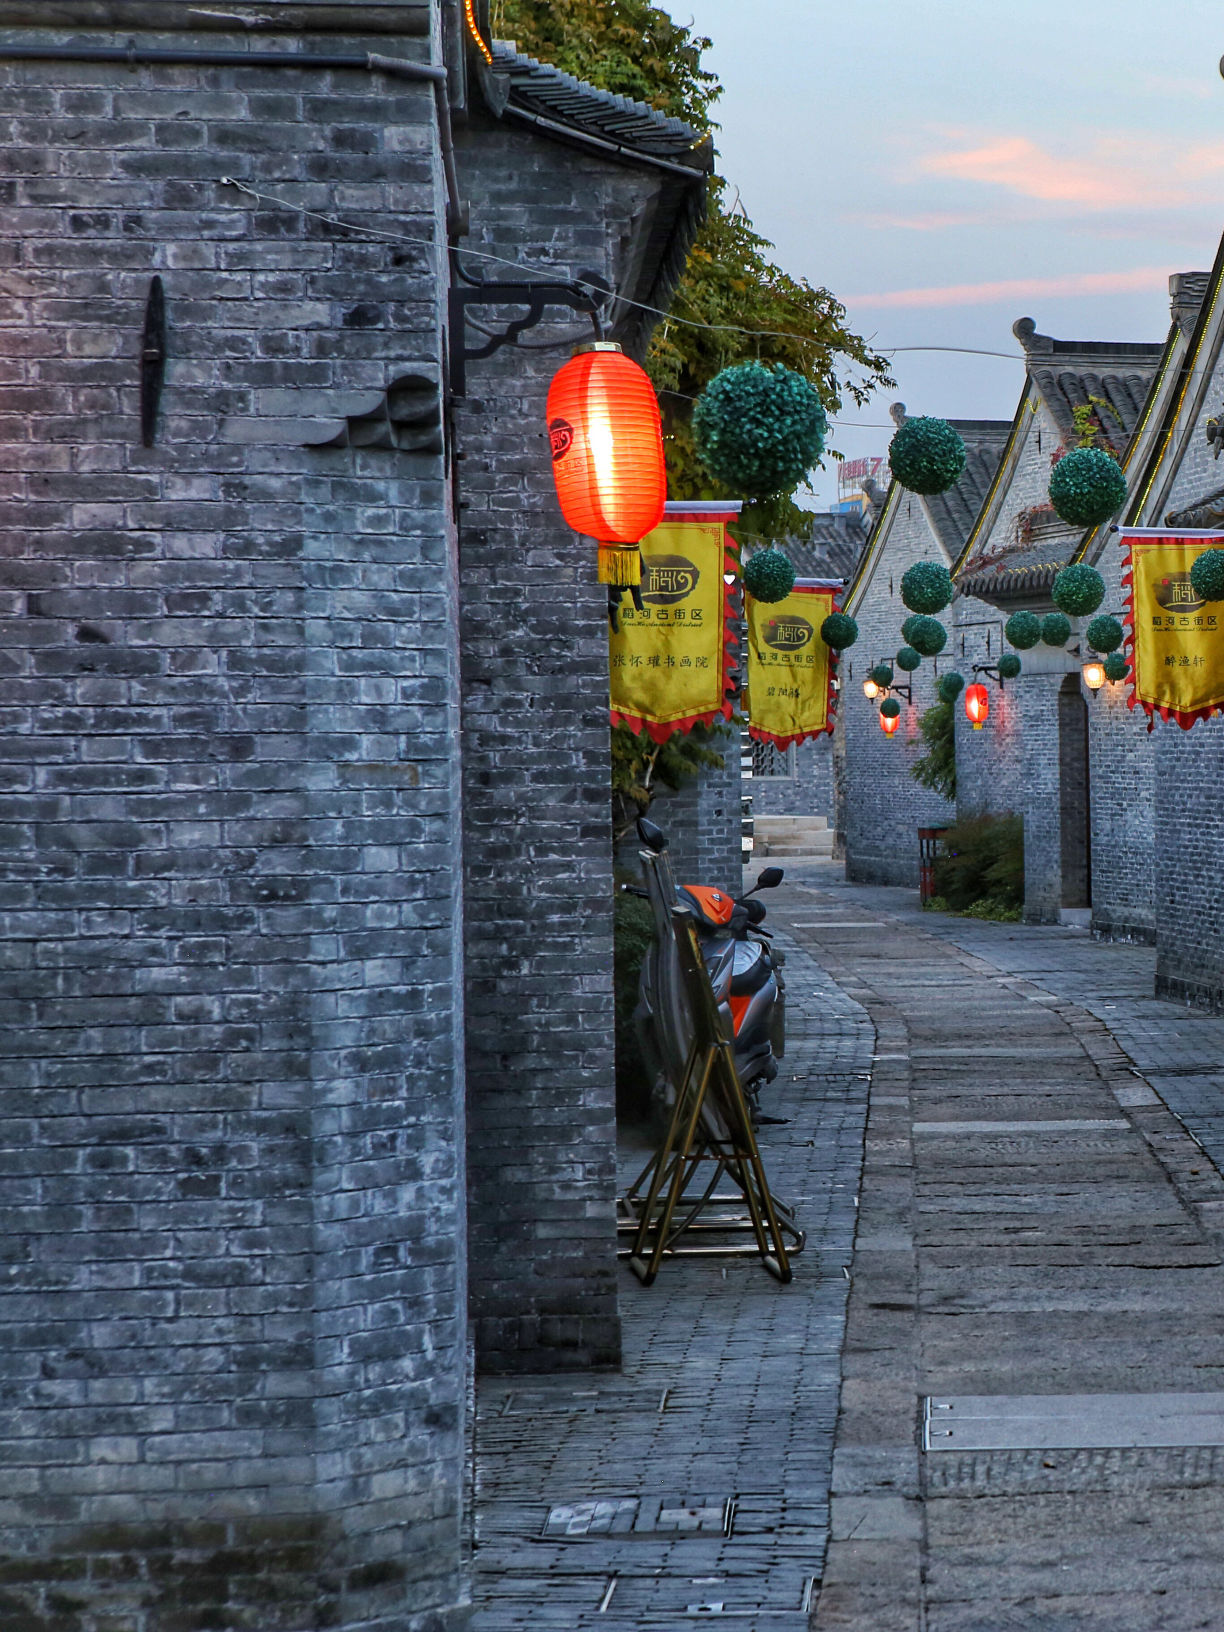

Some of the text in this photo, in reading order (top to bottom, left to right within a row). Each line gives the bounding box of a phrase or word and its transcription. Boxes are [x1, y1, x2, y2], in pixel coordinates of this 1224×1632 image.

[623, 607, 703, 620] 稻河古街区
